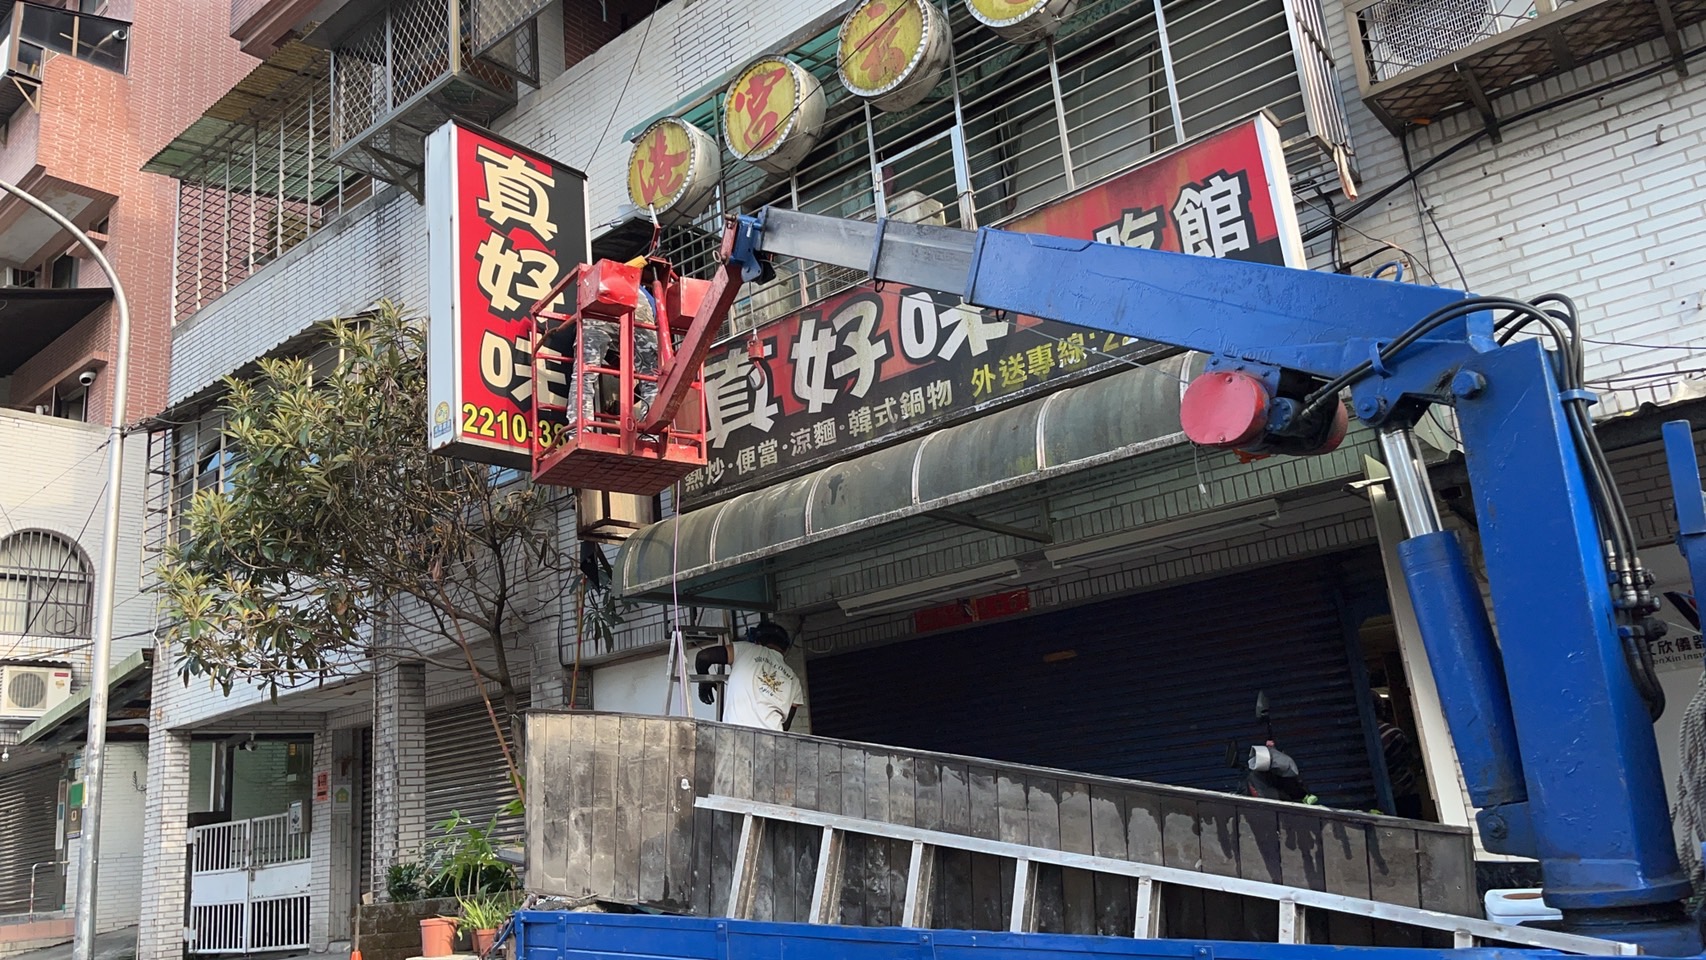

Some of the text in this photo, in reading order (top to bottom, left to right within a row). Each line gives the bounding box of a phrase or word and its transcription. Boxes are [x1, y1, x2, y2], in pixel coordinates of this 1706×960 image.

[477, 145, 566, 406] 真好味
[702, 292, 1009, 449] 真好味
